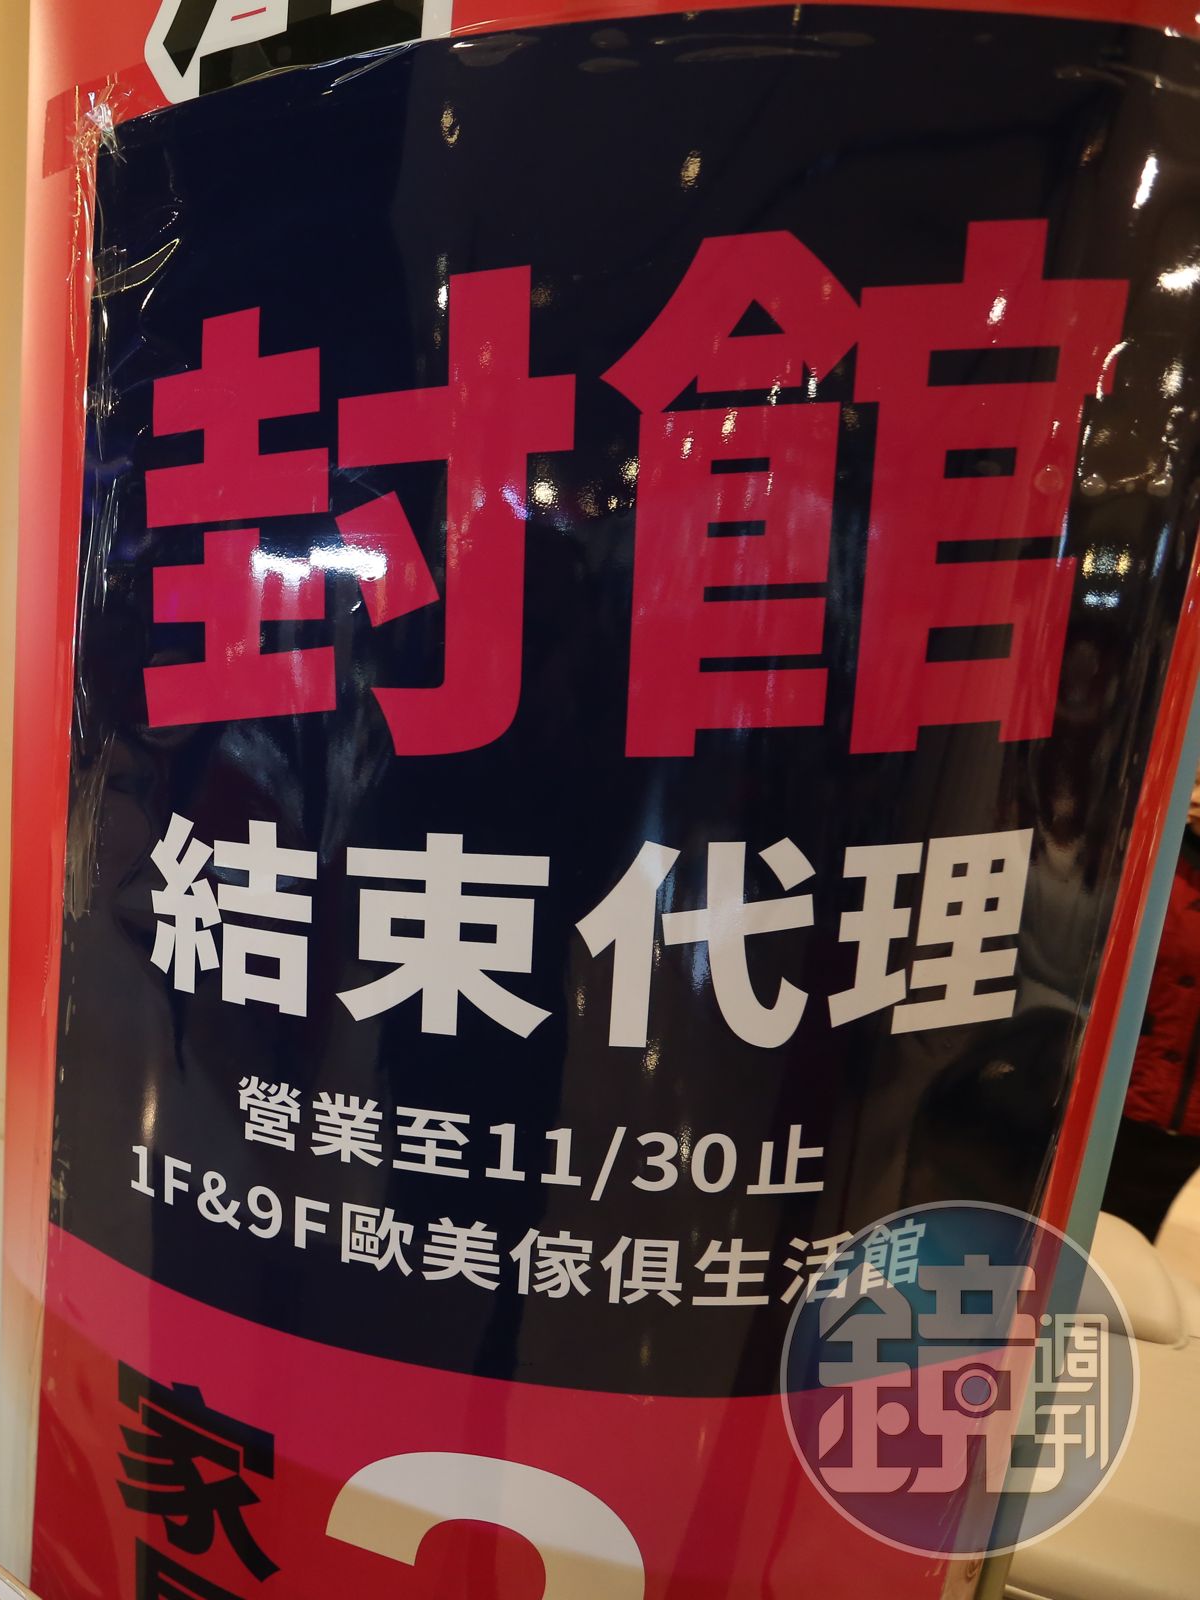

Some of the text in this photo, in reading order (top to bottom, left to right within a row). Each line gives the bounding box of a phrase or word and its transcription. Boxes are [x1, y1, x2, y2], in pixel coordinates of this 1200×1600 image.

[143, 218, 1129, 757] 封館
[151, 812, 1033, 1048] 結束代理
[130, 1145, 927, 1307] 1F&9F歐美傢俱生活館
[238, 1076, 825, 1201] 營業至11/30止
[116, 1360, 281, 1600] 家
